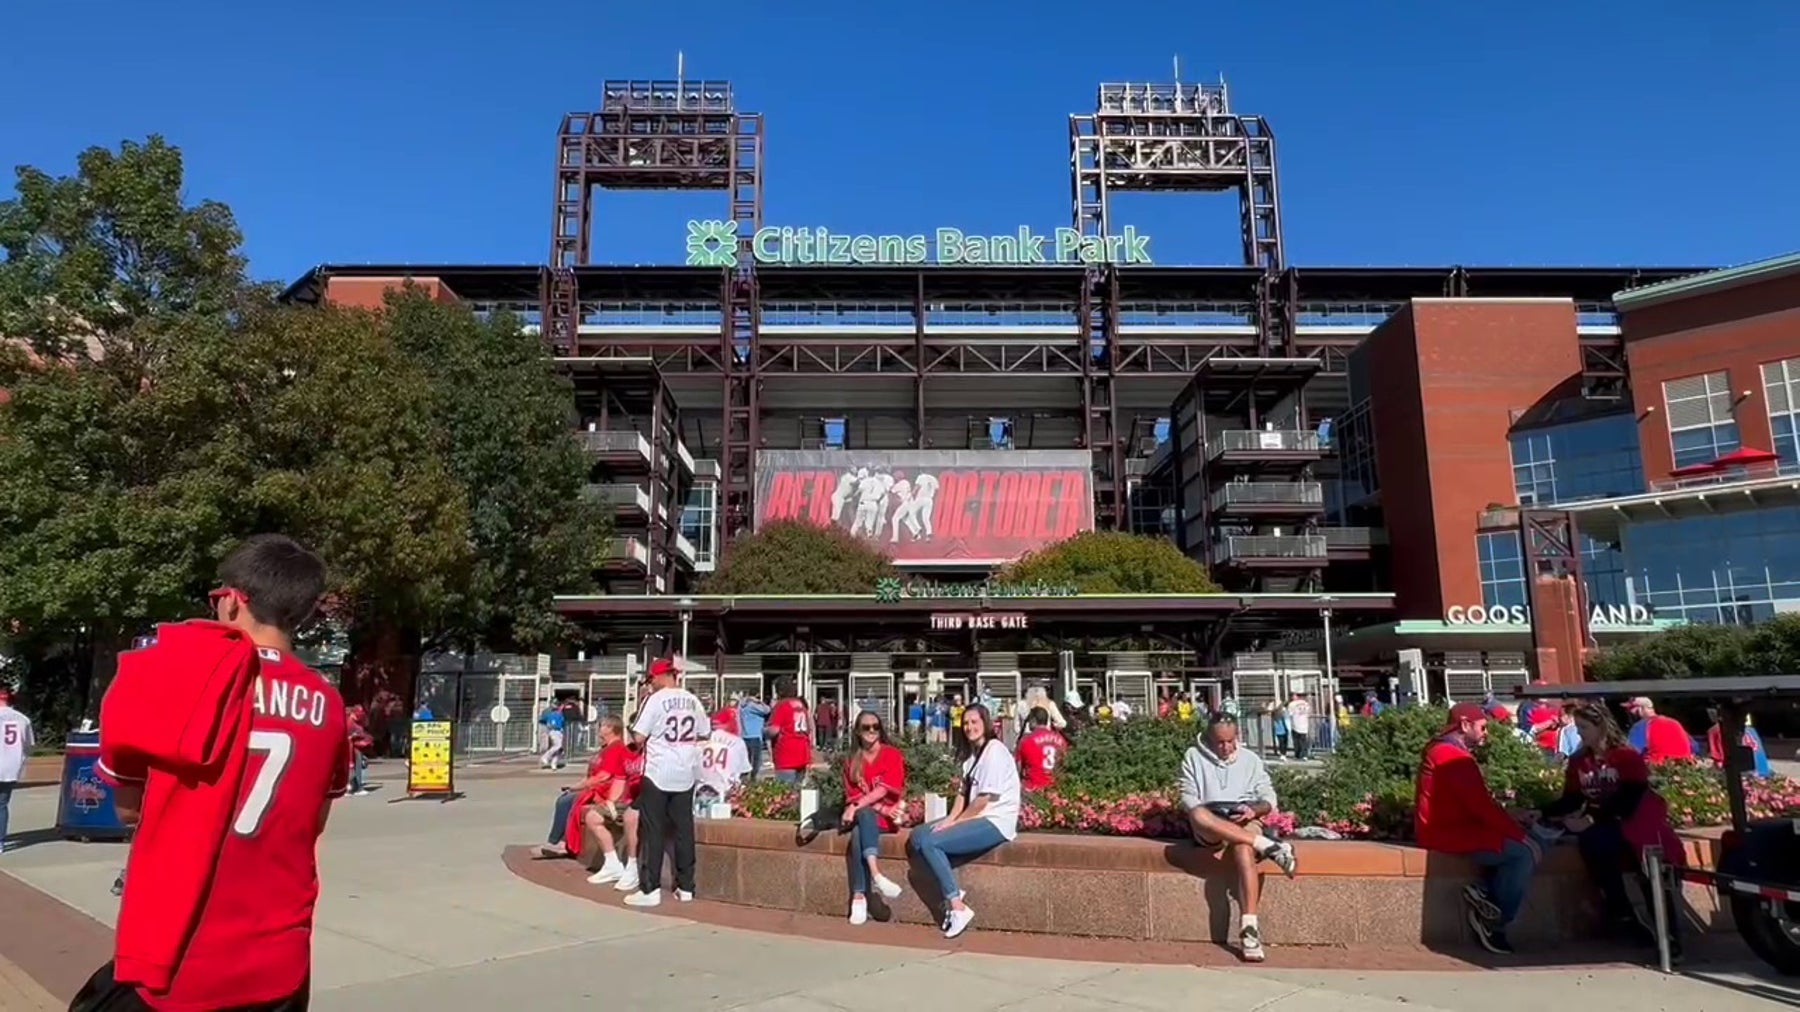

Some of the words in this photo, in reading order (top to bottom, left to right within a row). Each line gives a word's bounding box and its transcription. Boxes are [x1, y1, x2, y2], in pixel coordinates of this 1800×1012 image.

[752, 226, 927, 264] Citizens
[936, 226, 1044, 264] Bank
[1054, 225, 1150, 264] Park
[935, 471, 1085, 538] OCTOBER
[930, 616, 962, 629] THIRD
[968, 617, 995, 629] BASE
[1001, 616, 1029, 629] GATE
[1448, 605, 1530, 625] GOOS
[254, 674, 325, 726] ANCO
[664, 715, 696, 743] 32
[702, 747, 728, 769] 34
[1042, 745, 1056, 770] 3
[233, 730, 293, 835] 7
